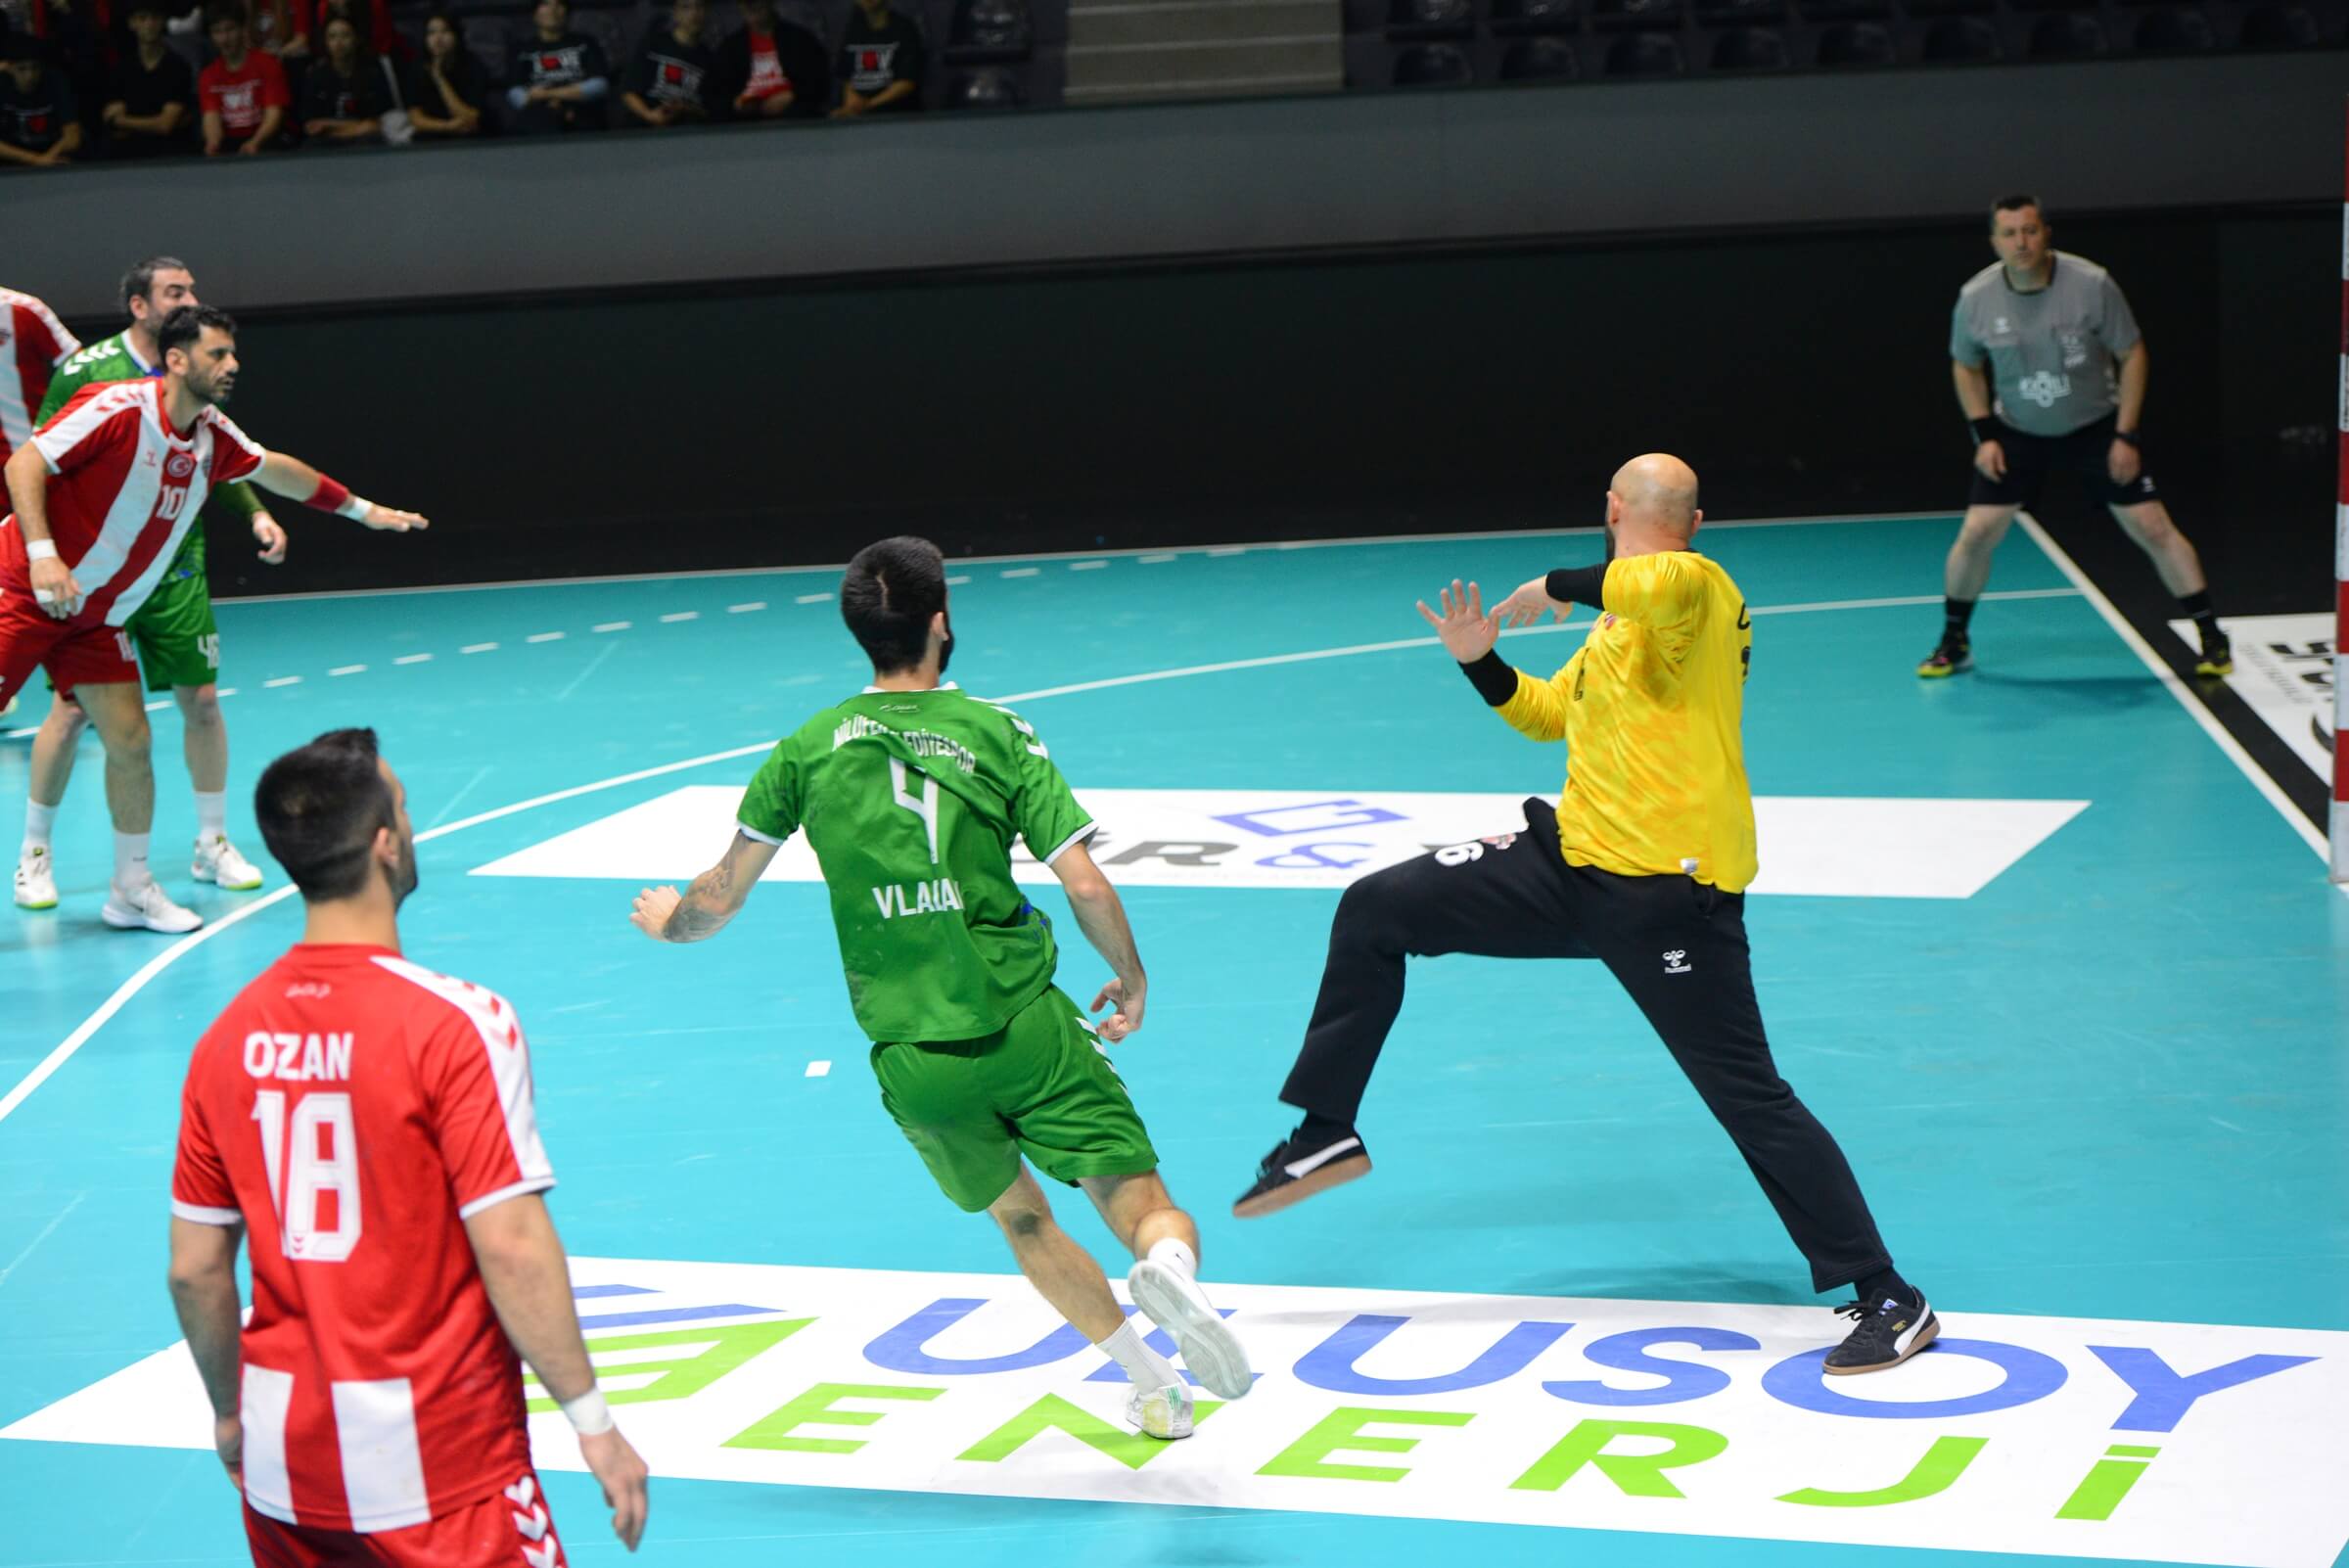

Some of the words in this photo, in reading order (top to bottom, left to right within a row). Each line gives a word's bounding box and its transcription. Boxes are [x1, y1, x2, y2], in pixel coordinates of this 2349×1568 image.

[157, 484, 188, 521] 10
[889, 755, 940, 864] 4
[244, 1031, 353, 1081] OZAN
[251, 1088, 363, 1263] 18
